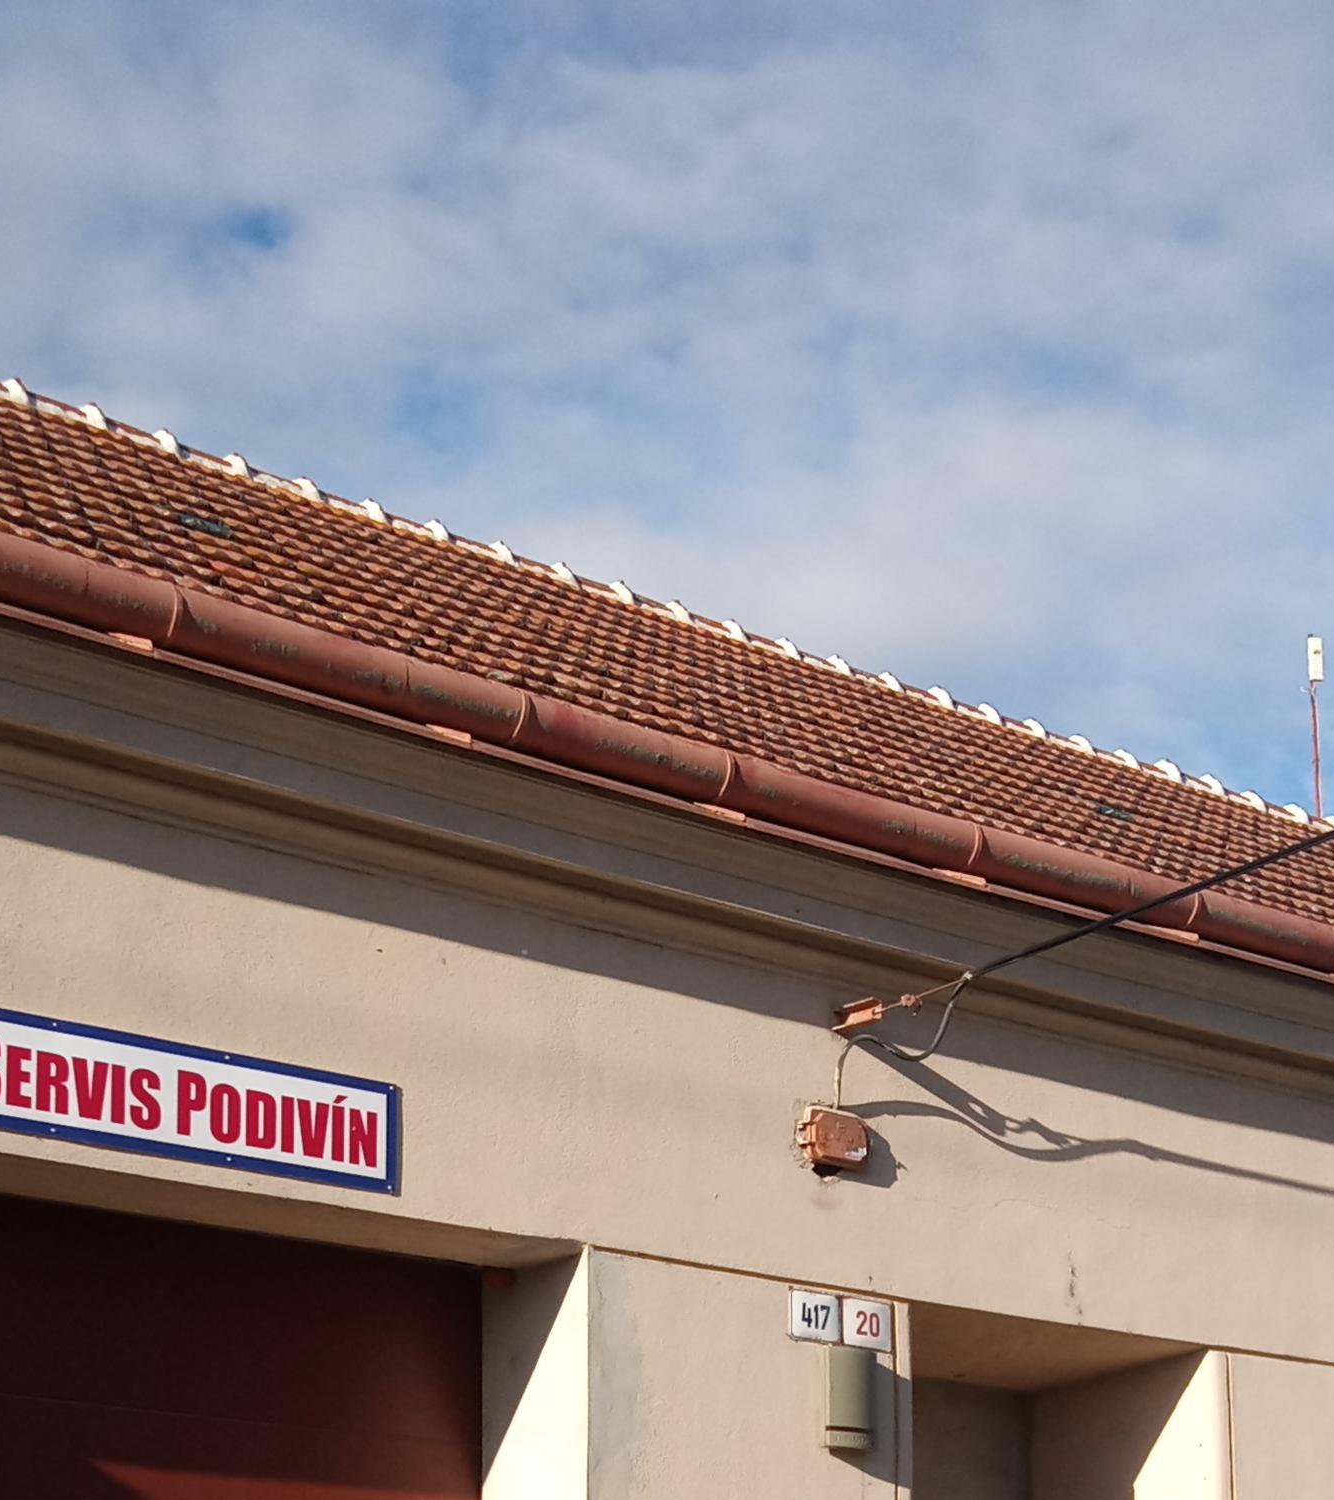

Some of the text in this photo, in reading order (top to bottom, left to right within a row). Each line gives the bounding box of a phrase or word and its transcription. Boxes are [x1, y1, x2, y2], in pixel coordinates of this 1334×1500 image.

[176, 1069, 378, 1168] PODIVÍN
[801, 1302, 831, 1331] 417
[855, 1311, 880, 1338] 20
